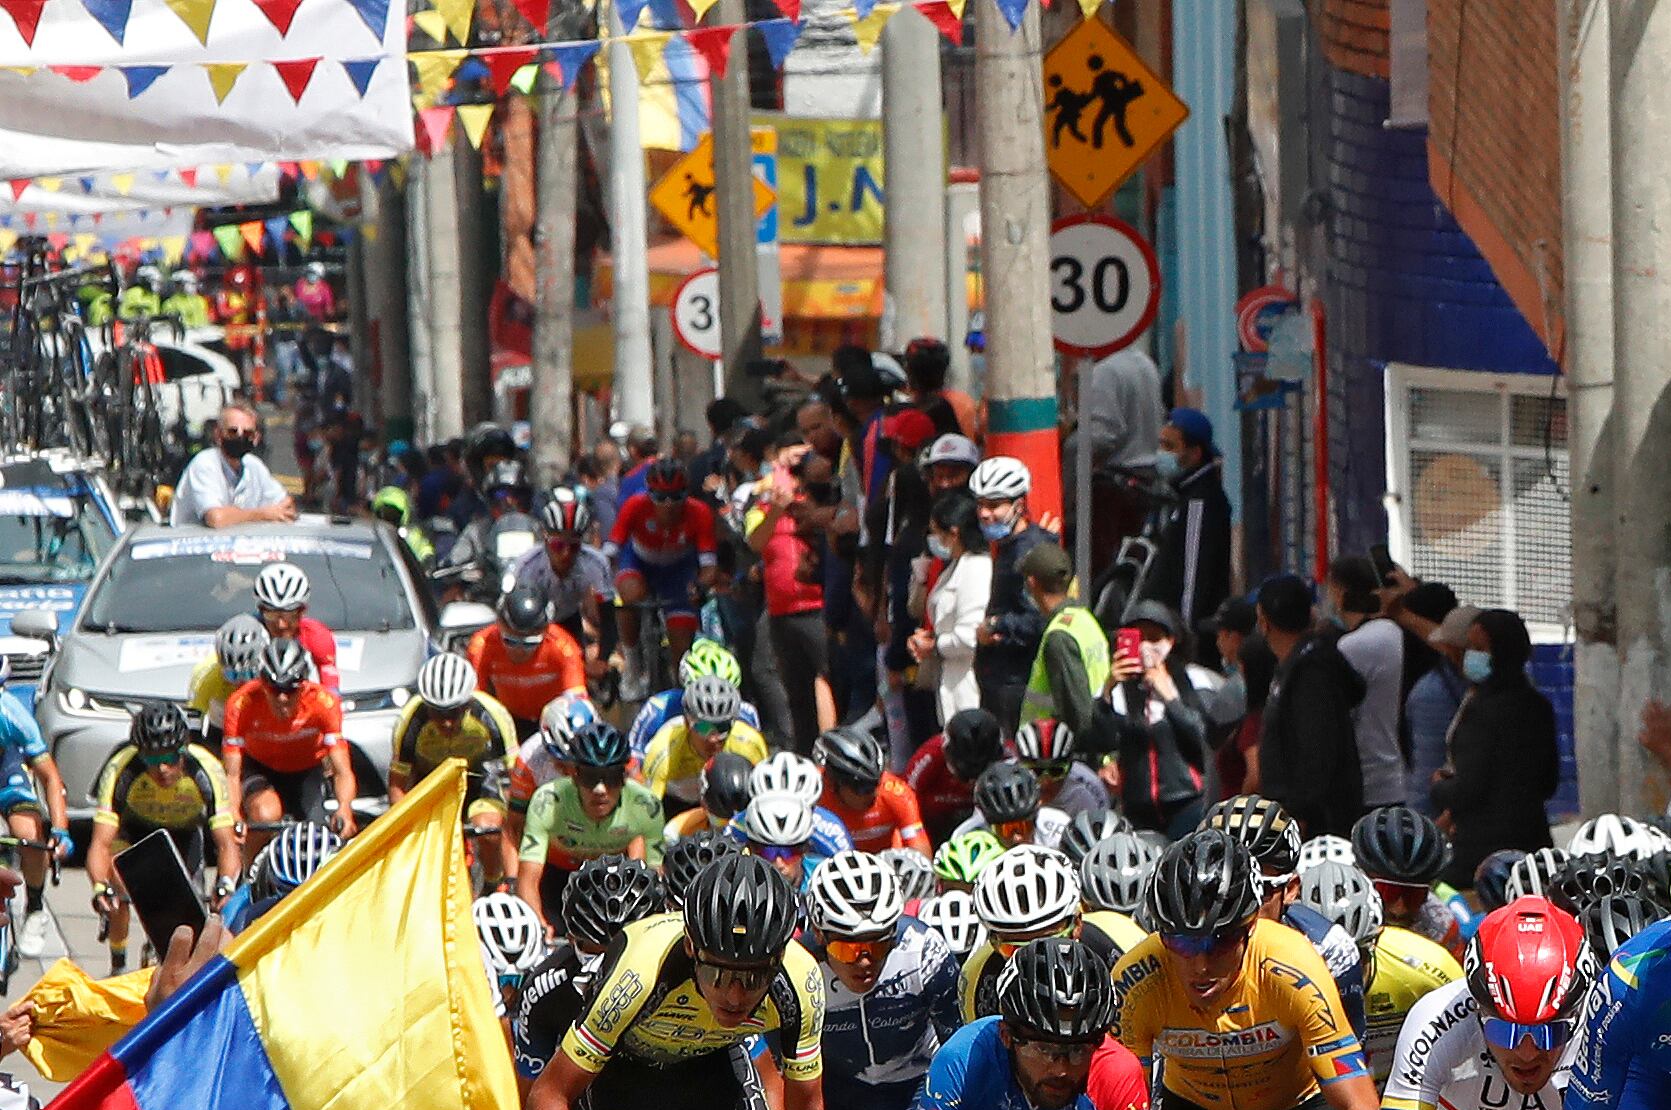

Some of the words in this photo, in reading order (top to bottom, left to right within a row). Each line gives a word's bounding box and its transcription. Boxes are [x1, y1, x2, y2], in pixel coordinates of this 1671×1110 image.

[1050, 256, 1130, 313] 30
[1518, 923, 1543, 932] UAE
[1485, 962, 1504, 1007] MET
[1166, 1026, 1280, 1049] COLOMBIA
[1410, 996, 1480, 1067] COLNAGO
